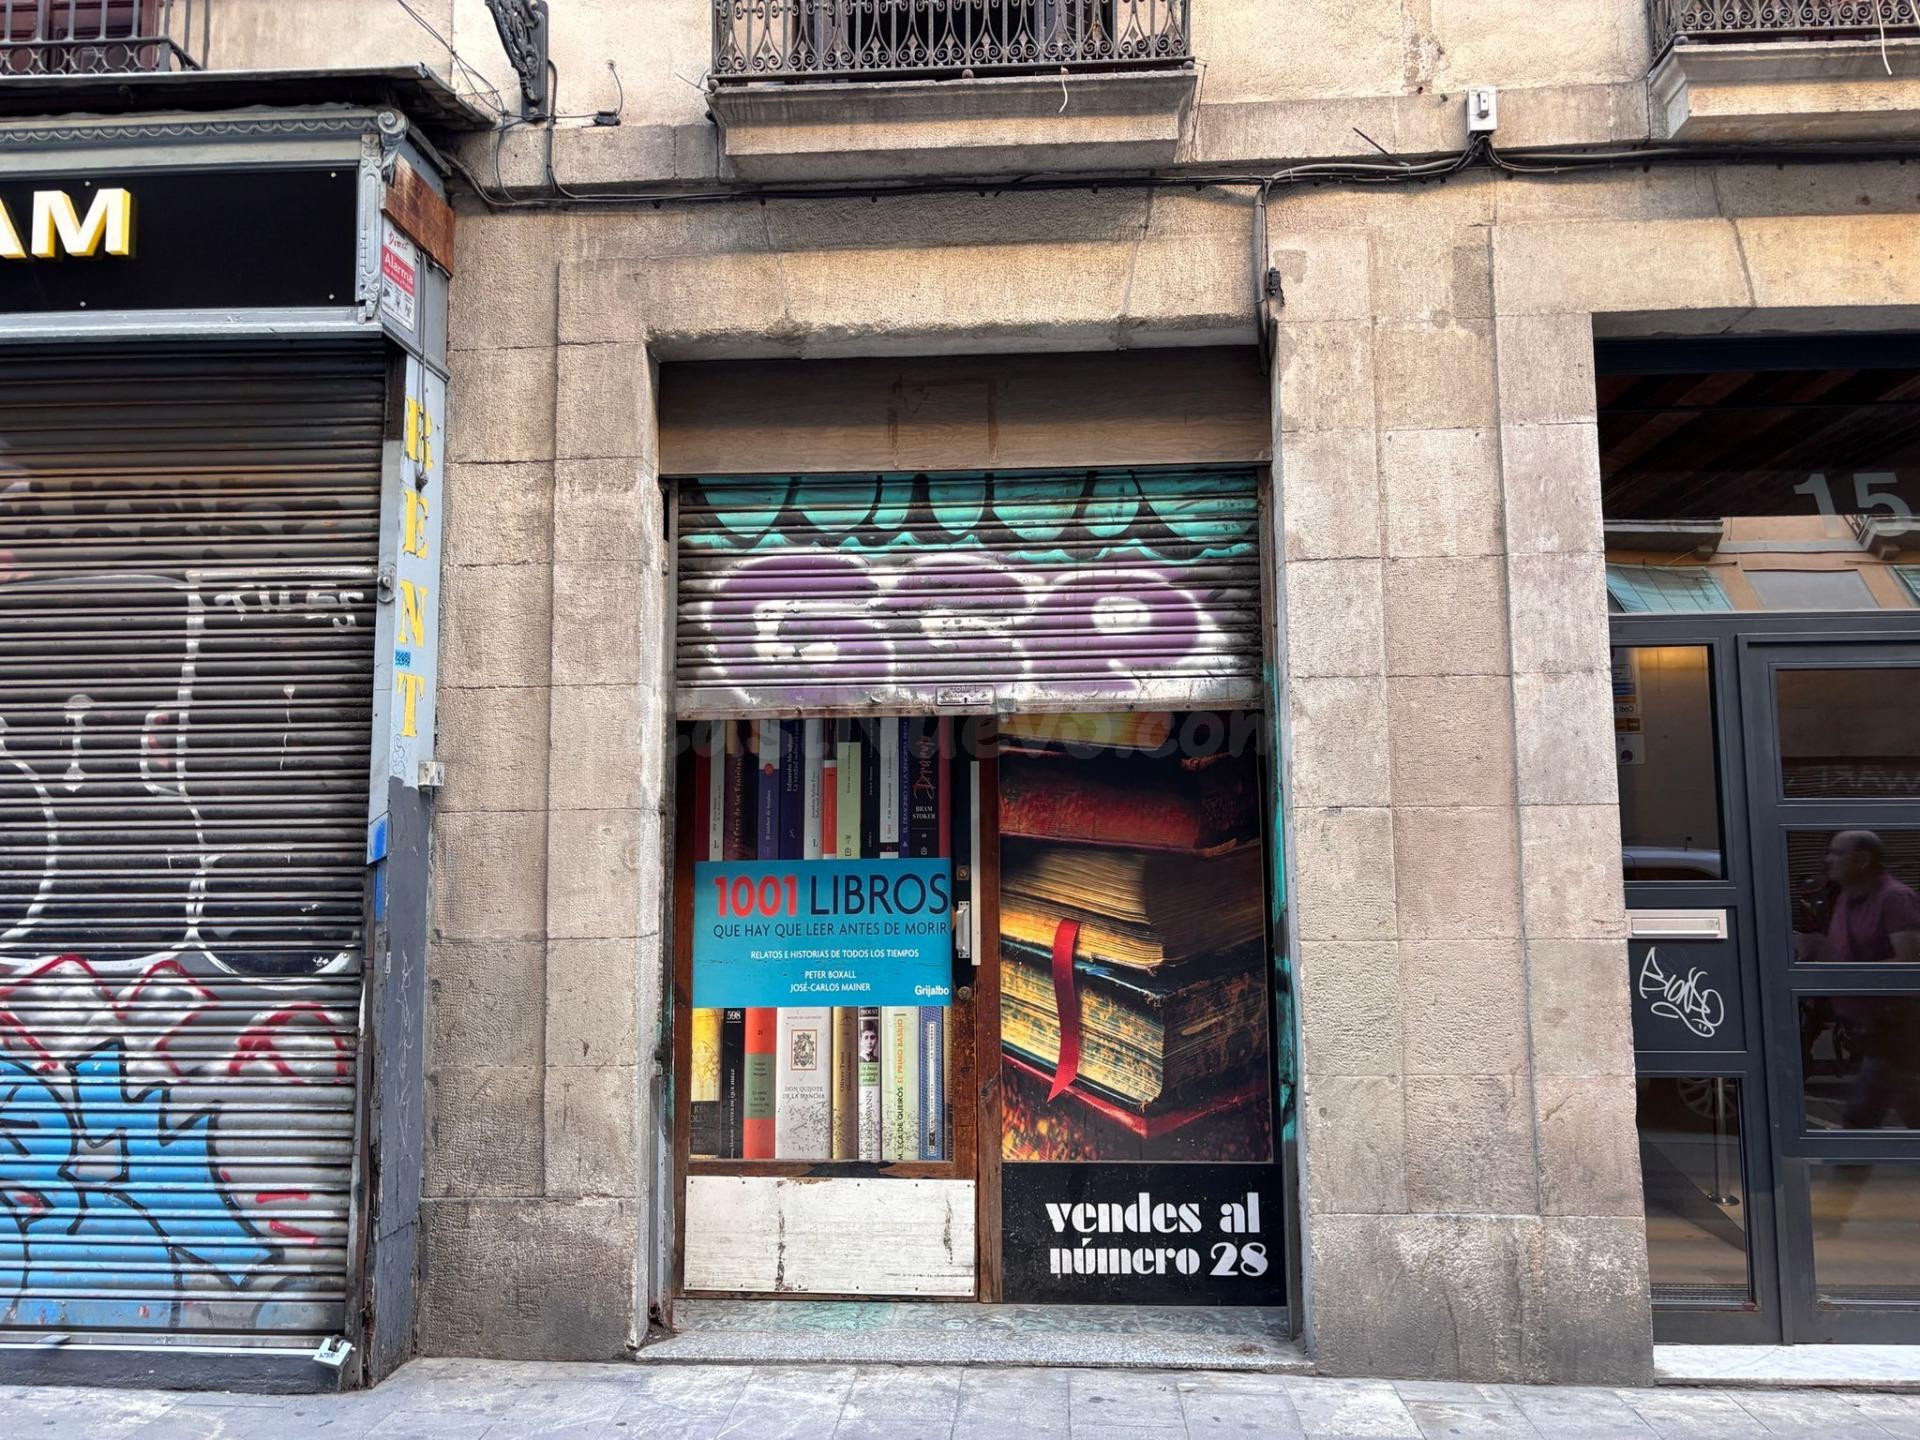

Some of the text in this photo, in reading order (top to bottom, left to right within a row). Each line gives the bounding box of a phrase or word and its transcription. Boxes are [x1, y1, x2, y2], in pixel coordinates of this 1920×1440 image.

[385, 253, 413, 284] Alarma
[1793, 471, 1914, 538] 15
[714, 872, 949, 918] 1001 LIBROS
[713, 921, 949, 940] QUE HAY QUE LEER ANTES DE MORIR
[751, 948, 782, 960] RELATOS
[790, 949, 829, 959] HISTORIAS
[831, 949, 840, 959] DE
[842, 949, 868, 959] TODOS
[870, 948, 885, 959] LOS
[886, 948, 919, 959] TIEMPOS
[805, 970, 857, 980] PETER BOXALL
[790, 980, 871, 993] JOSÉ-CARLOS MAINER
[914, 984, 950, 997] Grijalbo
[726, 1010, 741, 1020] 598
[897, 1121, 904, 1132] DE
[1045, 1192, 1260, 1233] vendes al
[1050, 1237, 1269, 1277] número 28
